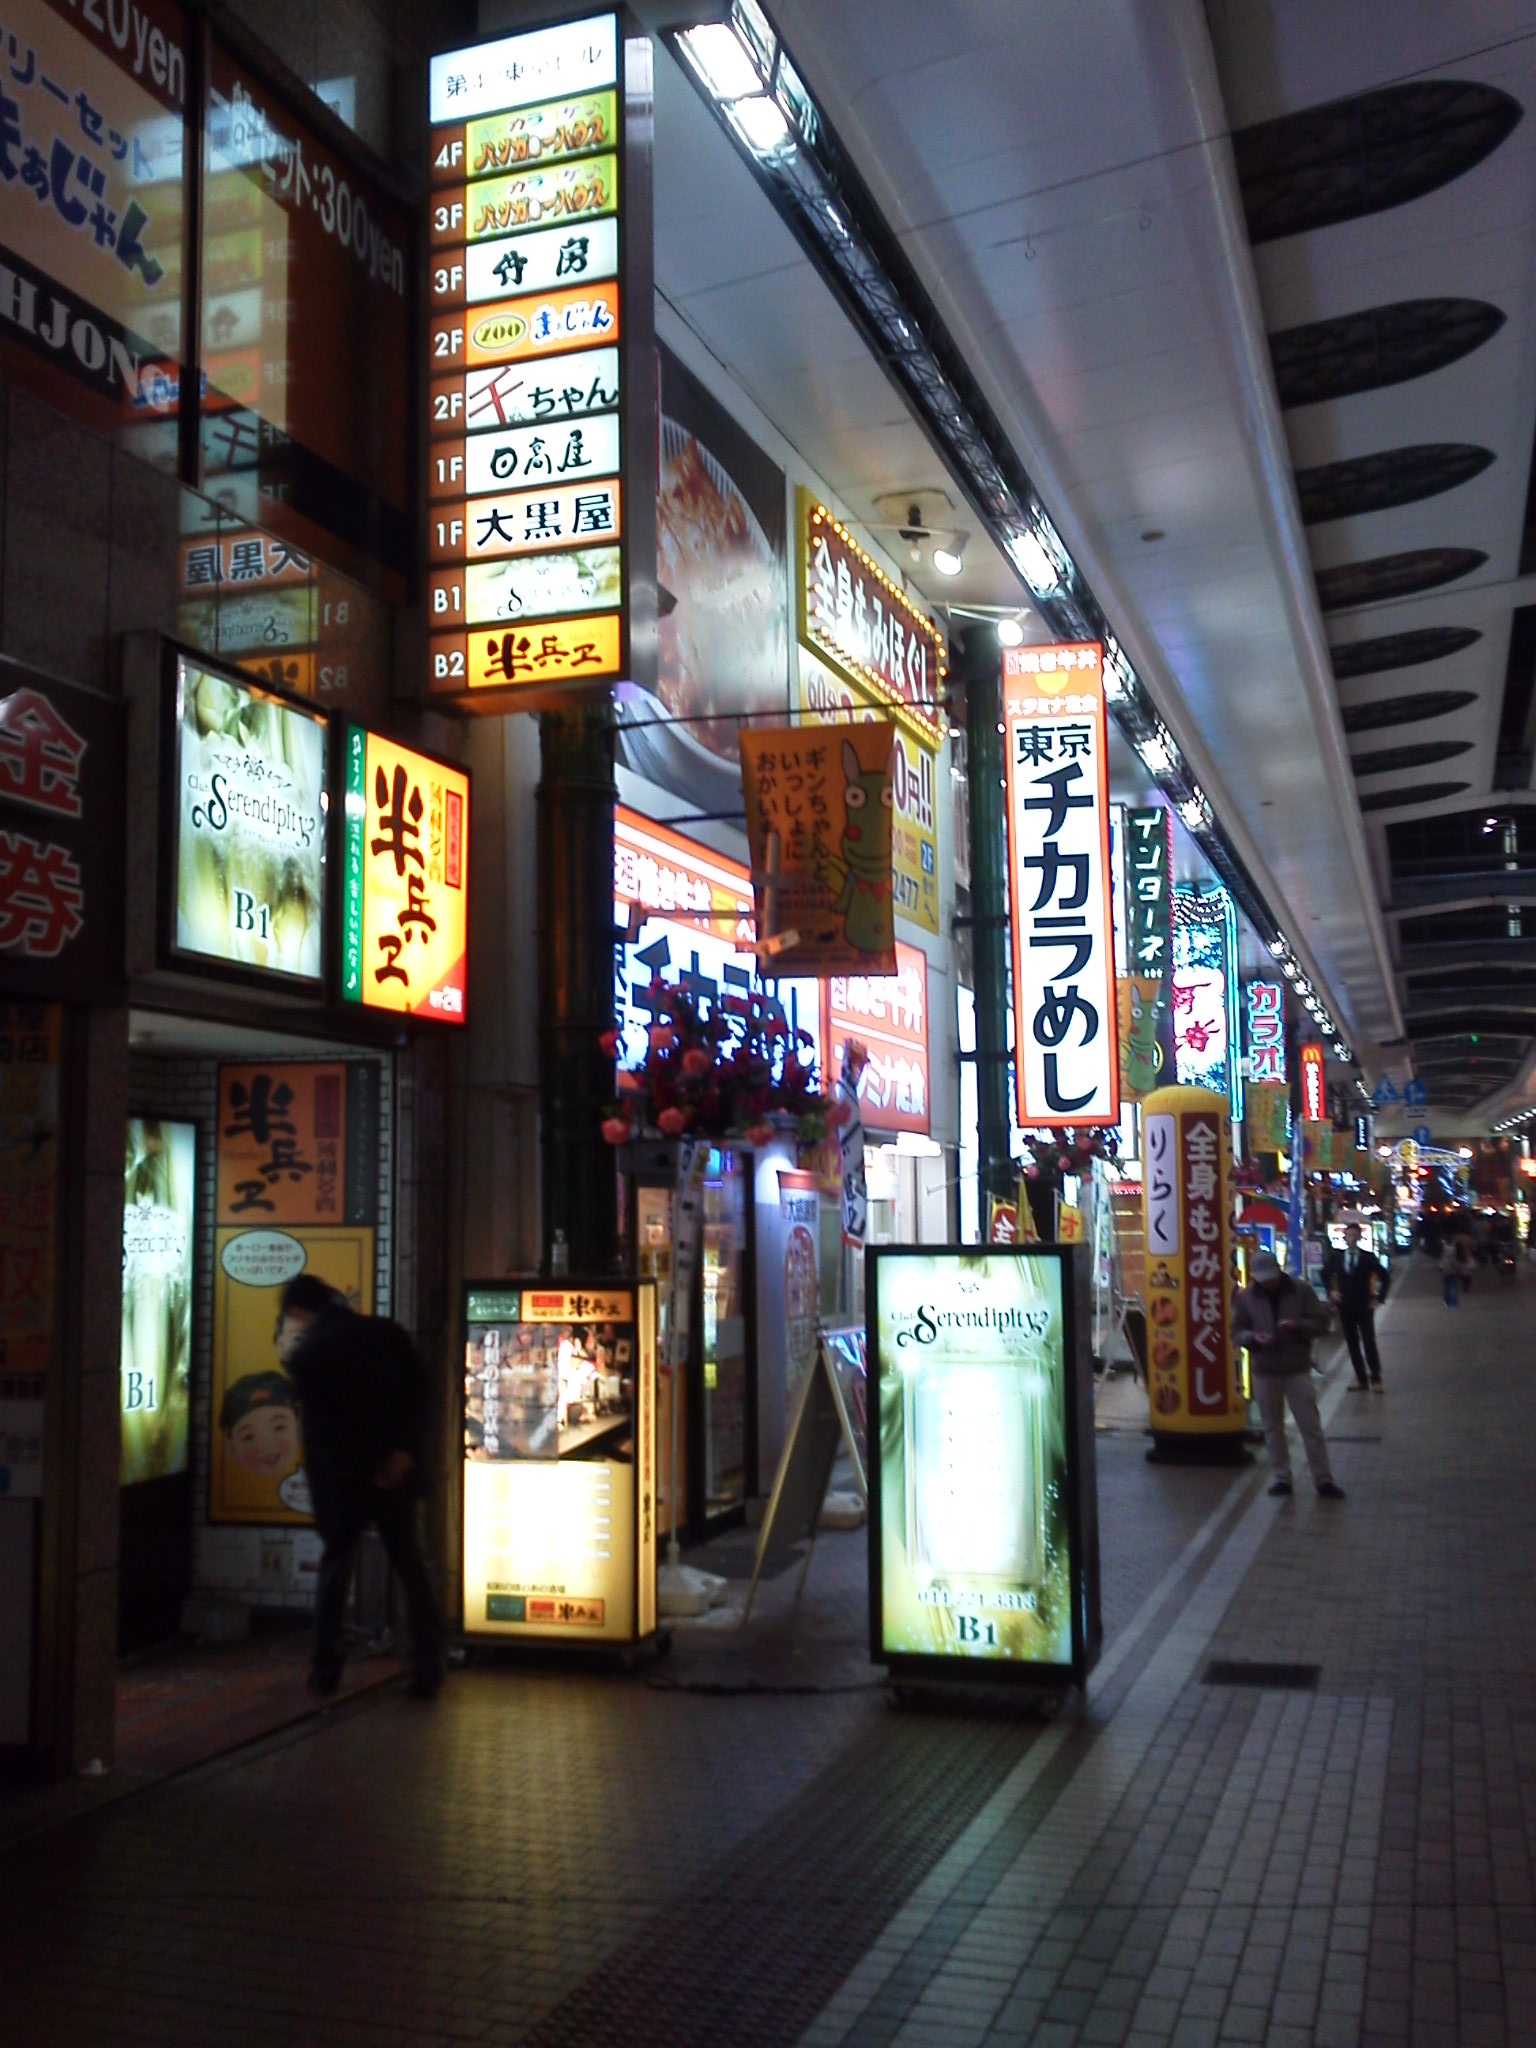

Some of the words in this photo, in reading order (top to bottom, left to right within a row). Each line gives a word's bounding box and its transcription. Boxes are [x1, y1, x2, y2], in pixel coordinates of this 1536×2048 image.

[66, 0, 186, 104] 20yen
[0, 28, 156, 178] リーセット
[434, 140, 463, 168] 4F
[434, 203, 463, 232] 3F
[434, 265, 463, 294] 3F
[434, 329, 463, 358] 2F
[475, 317, 526, 346] ZOO
[533, 304, 612, 341] まじん
[433, 392, 463, 421] 2F
[436, 456, 463, 484] 1F
[490, 429, 592, 479] 日高屋
[436, 520, 463, 548] 1F
[476, 493, 613, 547] 大黒屋
[434, 586, 461, 613] B1
[814, 535, 935, 717] 全身もみほぐし
[434, 651, 464, 678] B2
[1015, 723, 1093, 765] 東京
[0, 688, 88, 958] 金券
[191, 773, 316, 848] Serendipity
[756, 751, 778, 860] おかいも
[921, 843, 934, 871] 2F
[233, 889, 269, 939] B1
[1134, 808, 1165, 978] インターネ
[1023, 762, 1100, 1113] チカラめし
[1250, 983, 1283, 1082] カラオ
[832, 1042, 926, 1116] ミナ定食
[1149, 1126, 1173, 1242] りらく
[1184, 1121, 1223, 1405] 全身もみほぐし
[896, 1304, 1050, 1348] Serendipity
[126, 1371, 156, 1409] B1
[956, 1614, 998, 1647] B1
